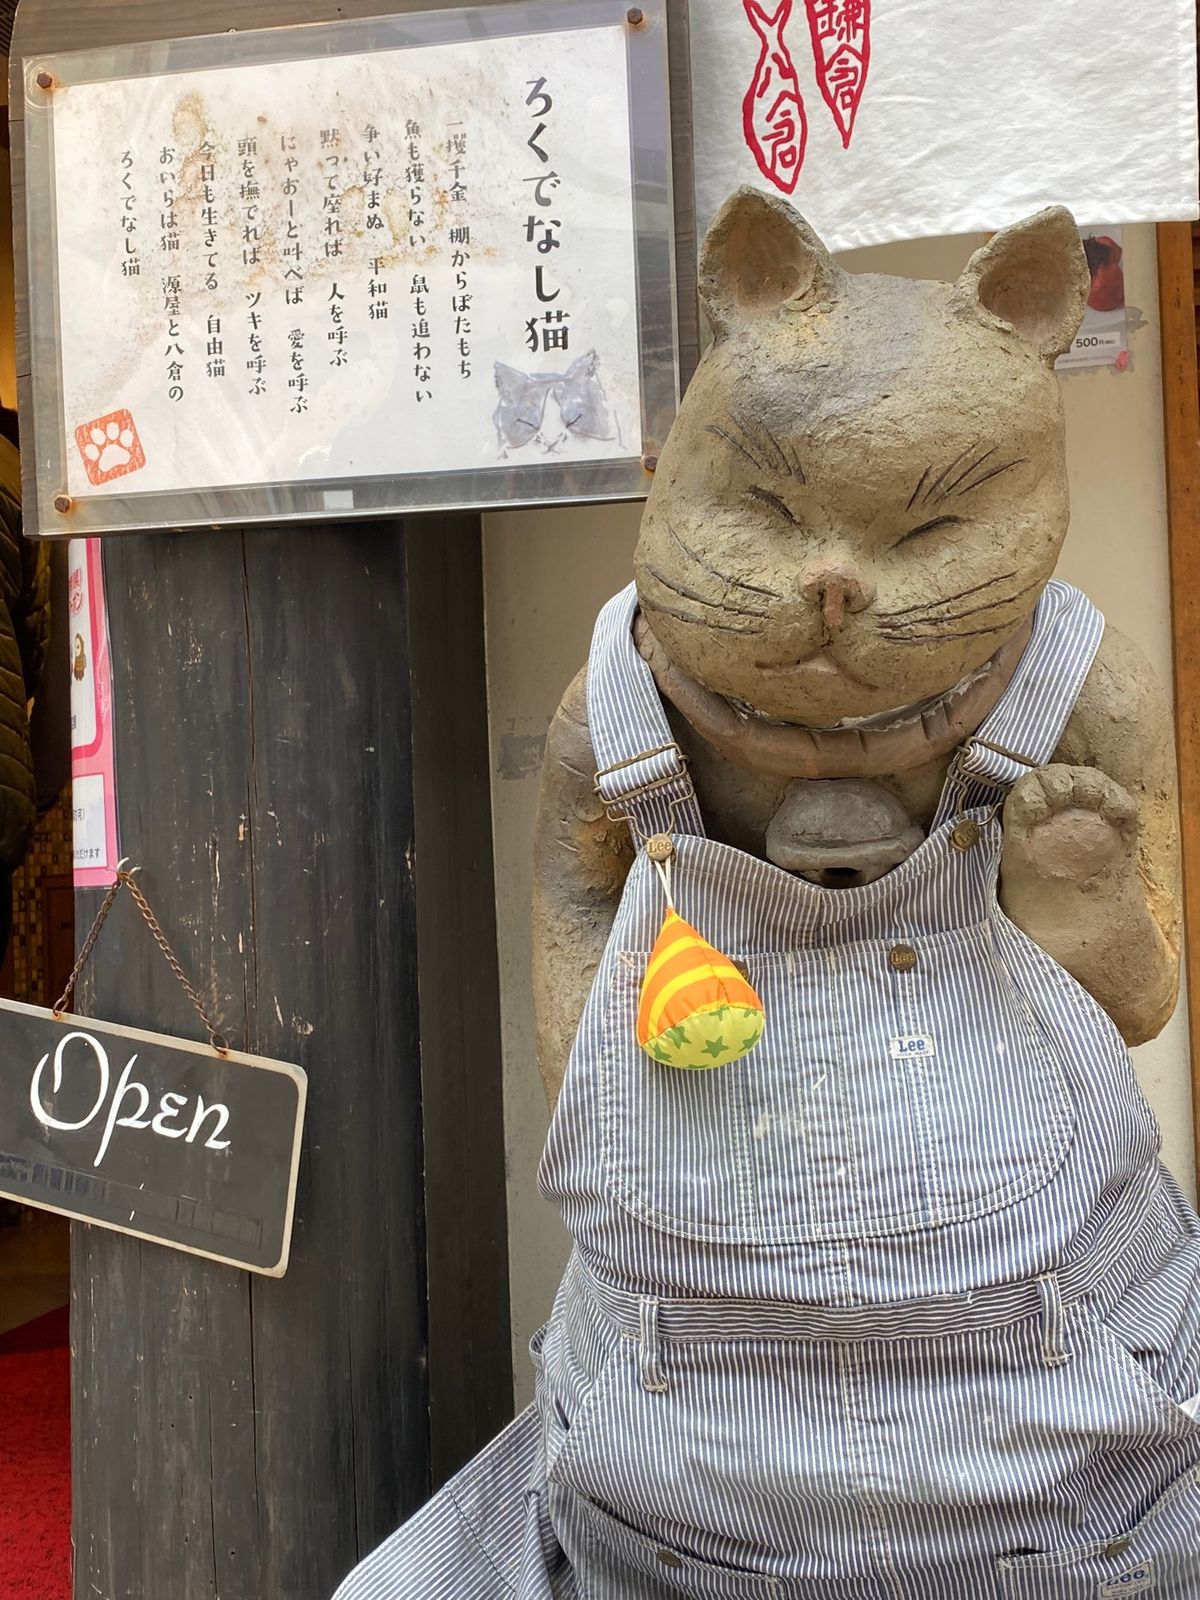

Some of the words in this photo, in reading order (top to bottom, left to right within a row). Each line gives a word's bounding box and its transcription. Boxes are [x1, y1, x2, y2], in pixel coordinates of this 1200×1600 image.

[120, 150, 141, 277] ろくでなし猫
[159, 146, 181, 251] おいらは猫
[199, 140, 219, 291] 今日も生きてる
[237, 135, 262, 266] 頭を撫でれば
[281, 135, 304, 305] にゃおーと叫べば
[320, 128, 343, 257] 黙って座れば
[362, 123, 385, 230] 争い好まぬ
[404, 119, 426, 247] 魚も獲らない
[522, 76, 571, 353] ろくでなし猫
[161, 274, 185, 402] 源屋と八倉の
[206, 314, 226, 378] 自由猫
[245, 291, 267, 396] ツキを呼ぶ
[327, 283, 348, 367] 人を呼ぶ
[367, 256, 388, 320] 平和猫
[409, 274, 433, 402] 鼠も追わない
[448, 226, 473, 379] 棚からぼたもち
[287, 328, 309, 414] 愛を呼ぶ
[648, 840, 672, 854] Lee
[891, 951, 916, 963] Lee
[30, 1031, 232, 1167] Open
[898, 1039, 926, 1052] Lee
